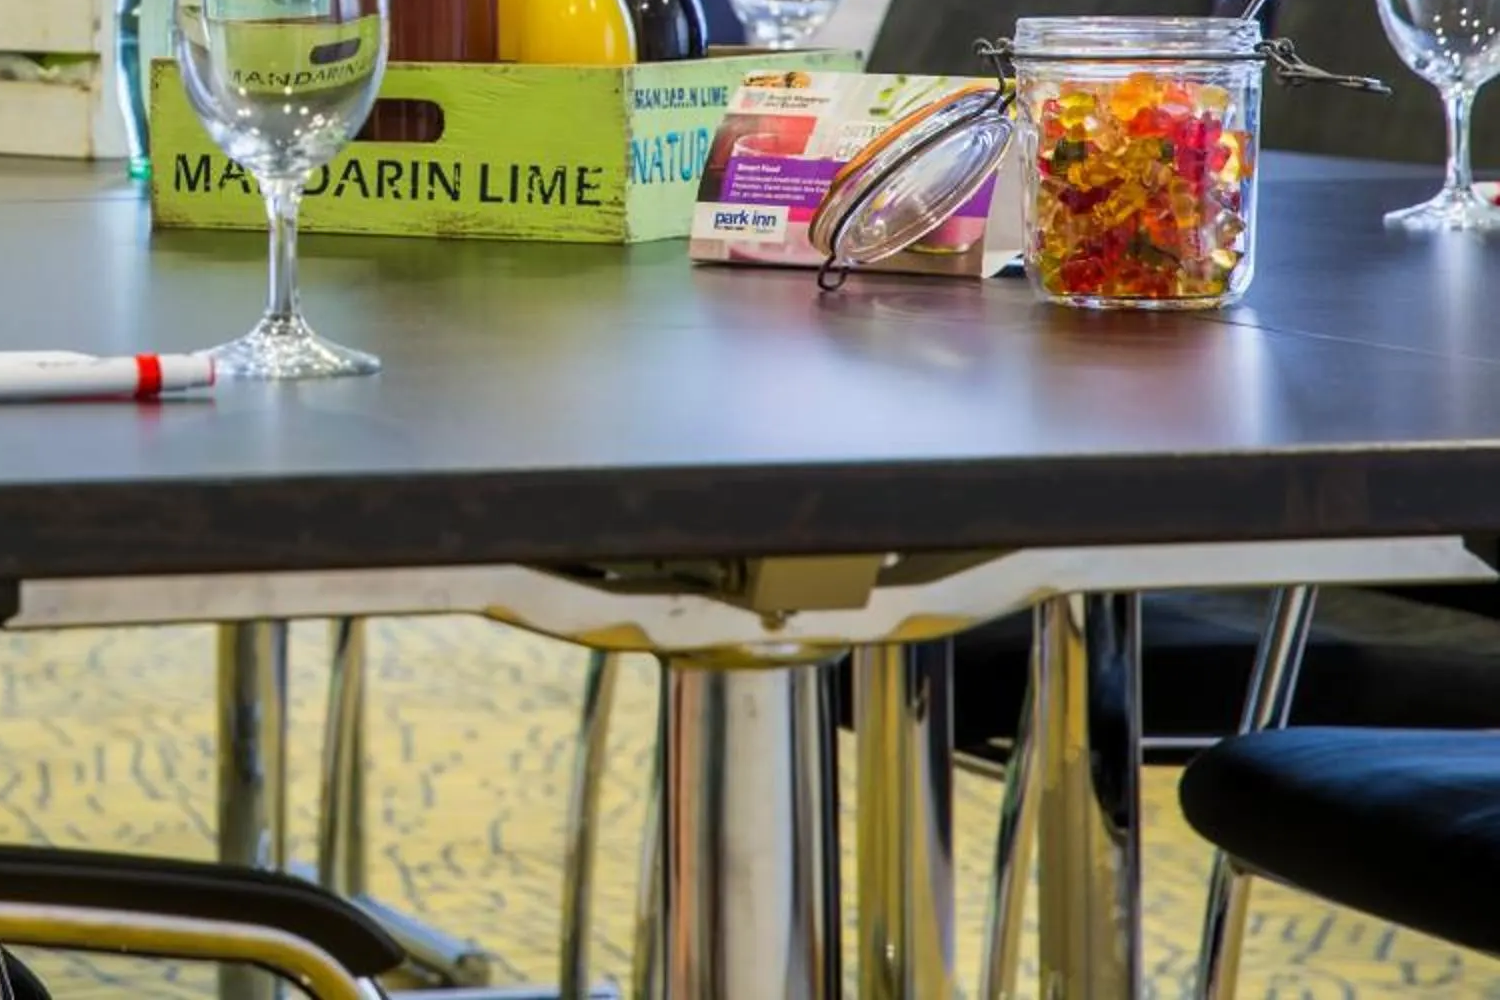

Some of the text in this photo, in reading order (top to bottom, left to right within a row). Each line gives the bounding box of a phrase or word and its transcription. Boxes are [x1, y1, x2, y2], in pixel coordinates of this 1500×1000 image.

[174, 153, 602, 207] MADARIN LIME
[714, 209, 777, 229] park inn
